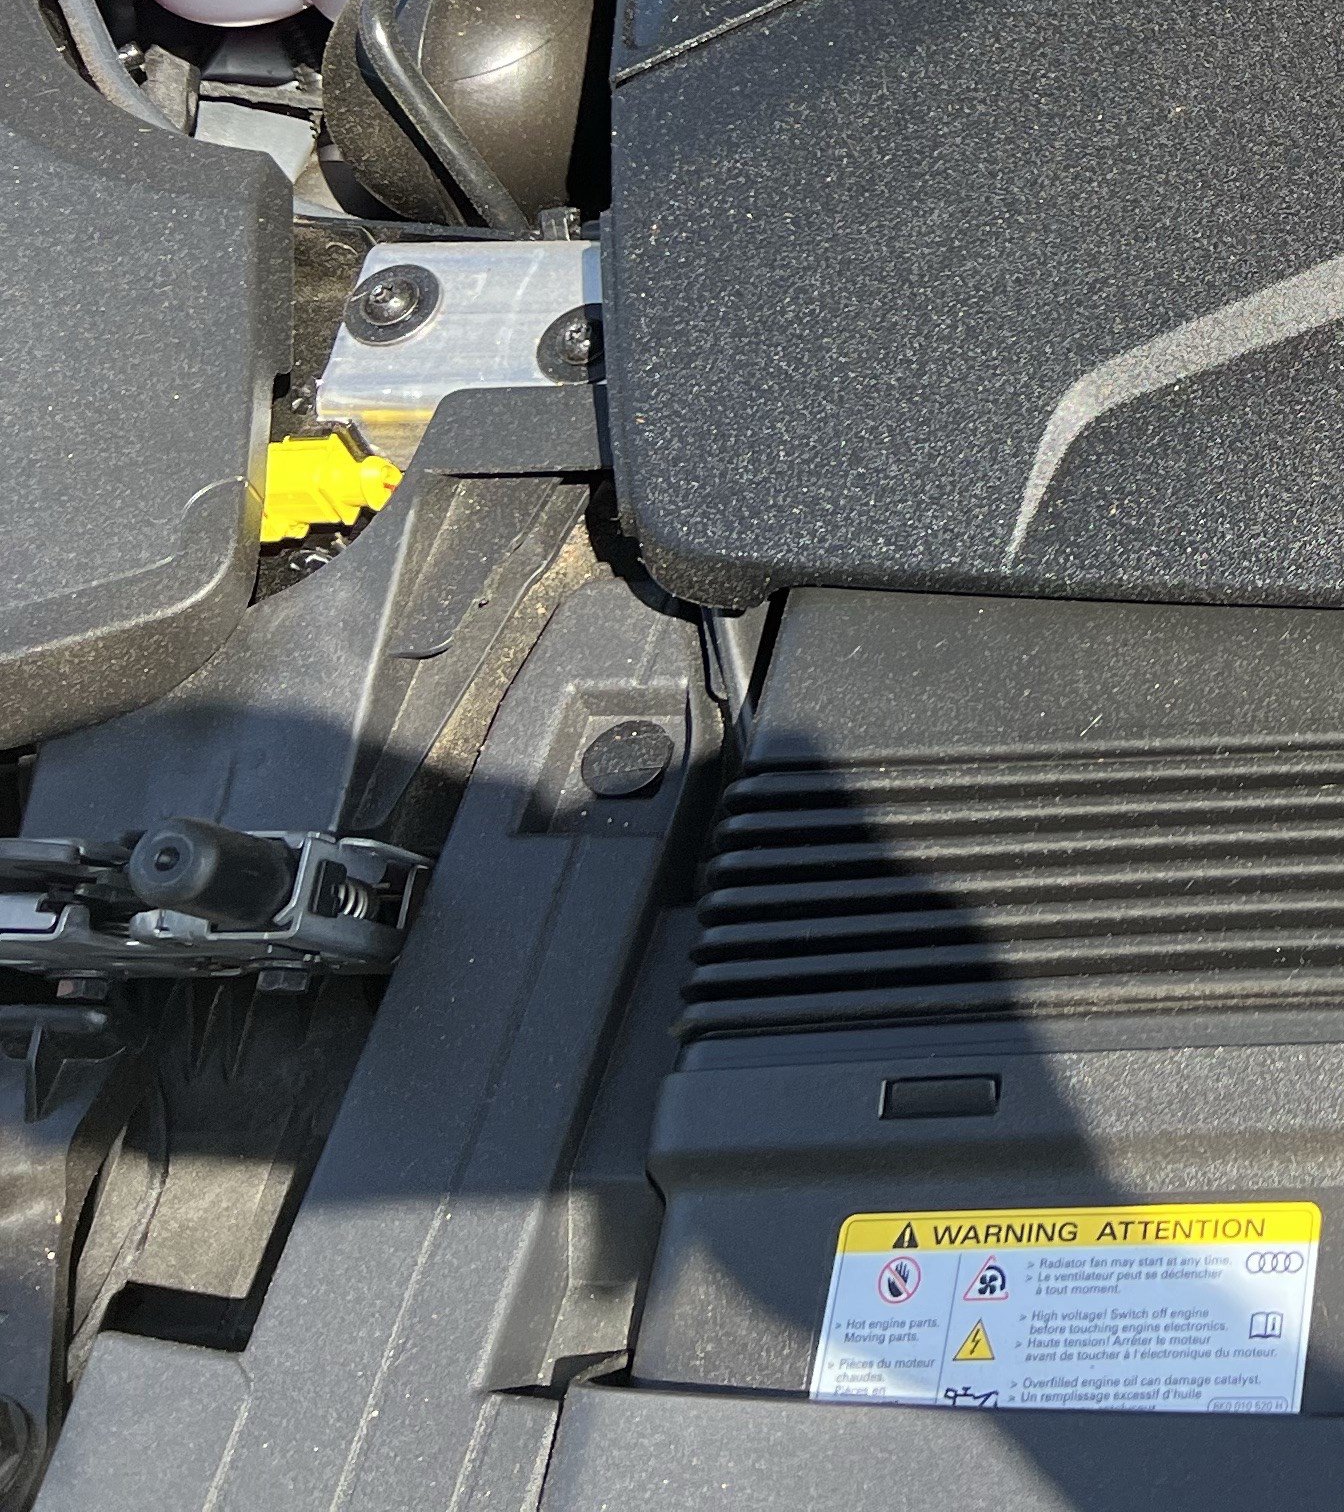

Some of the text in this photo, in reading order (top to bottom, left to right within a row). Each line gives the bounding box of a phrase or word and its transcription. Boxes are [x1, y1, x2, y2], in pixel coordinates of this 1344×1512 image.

[933, 1218, 1266, 1246] WARNING ATTENTION
[1039, 1256, 1086, 1269] Radiator
[1090, 1256, 1108, 1268] fan
[1110, 1258, 1136, 1268] may
[1138, 1256, 1163, 1267] start
[1166, 1257, 1177, 1266] at
[1180, 1258, 1201, 1268] any
[1037, 1268, 1223, 1282] Le ventilateur peut se déclencher
[1045, 1285, 1068, 1295] tout
[1031, 1309, 1058, 1324] High
[1110, 1308, 1149, 1320] Switch
[1152, 1308, 1168, 1319] off
[1170, 1308, 1209, 1320] engine
[846, 1318, 867, 1330] Hot
[869, 1317, 906, 1331] engine
[1029, 1323, 1066, 1335] before
[1069, 1322, 1119, 1335] touching
[1121, 1322, 1160, 1335] engine
[844, 1332, 885, 1344] Moving
[1027, 1337, 1060, 1348] Haute
[1156, 1335, 1166, 1345] le
[1169, 1335, 1211, 1345] moteur
[1025, 1351, 1057, 1362] avant
[1060, 1350, 1074, 1361] de
[1077, 1349, 1120, 1361] toucher
[1215, 1347, 1230, 1358] du
[876, 1358, 891, 1368] du
[894, 1358, 936, 1368] moteur
[1022, 1376, 1079, 1388] Overfilled
[1081, 1375, 1120, 1389] engine
[1123, 1375, 1138, 1386] oil
[1141, 1376, 1160, 1386] can
[1164, 1374, 1210, 1387] damage
[1021, 1391, 1037, 1402] Un
[1040, 1390, 1110, 1405] remplissage
[1113, 1389, 1160, 1400] excessif
